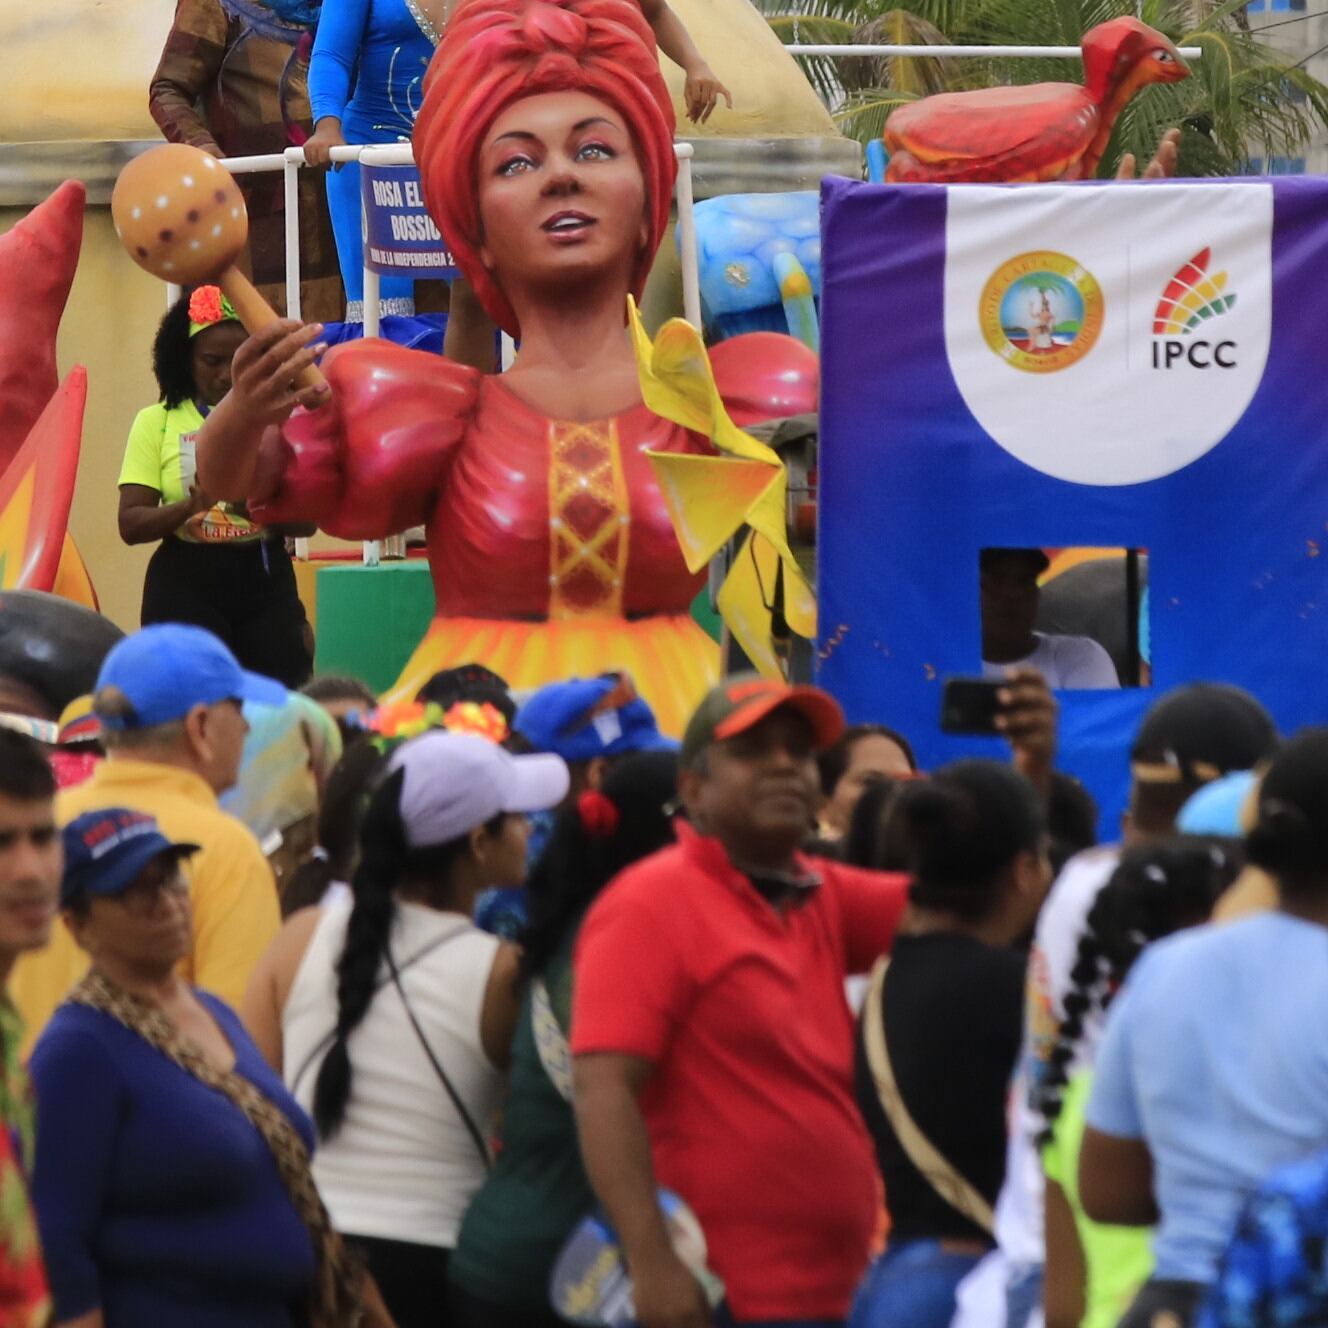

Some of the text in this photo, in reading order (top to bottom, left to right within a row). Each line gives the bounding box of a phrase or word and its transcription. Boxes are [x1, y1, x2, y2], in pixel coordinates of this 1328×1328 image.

[372, 179, 425, 208] ROSA EL
[393, 251, 447, 267] INDEPENDENCIA
[1152, 340, 1237, 370] IPCC
